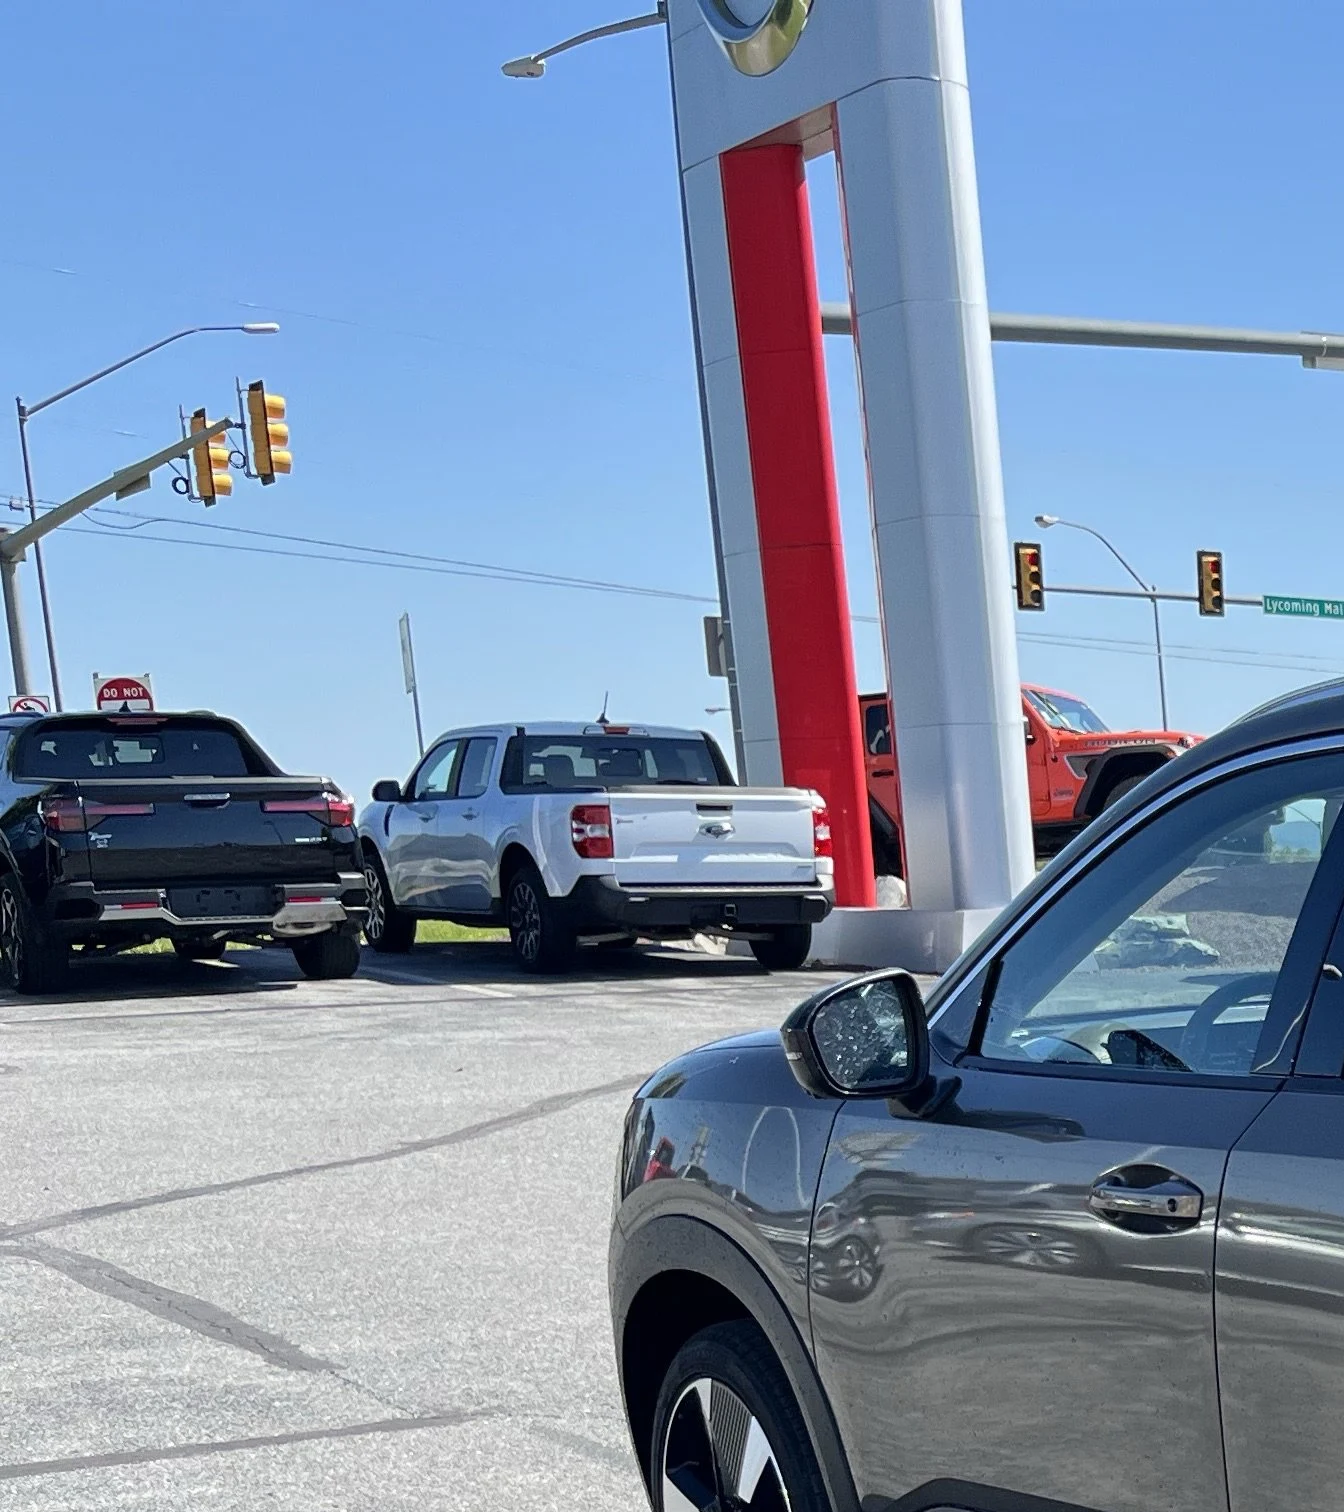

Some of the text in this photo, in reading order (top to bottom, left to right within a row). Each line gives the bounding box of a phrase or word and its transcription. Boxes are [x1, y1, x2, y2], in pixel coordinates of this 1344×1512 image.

[1266, 598, 1320, 616] Lycoming
[103, 687, 144, 698] DO NOT
